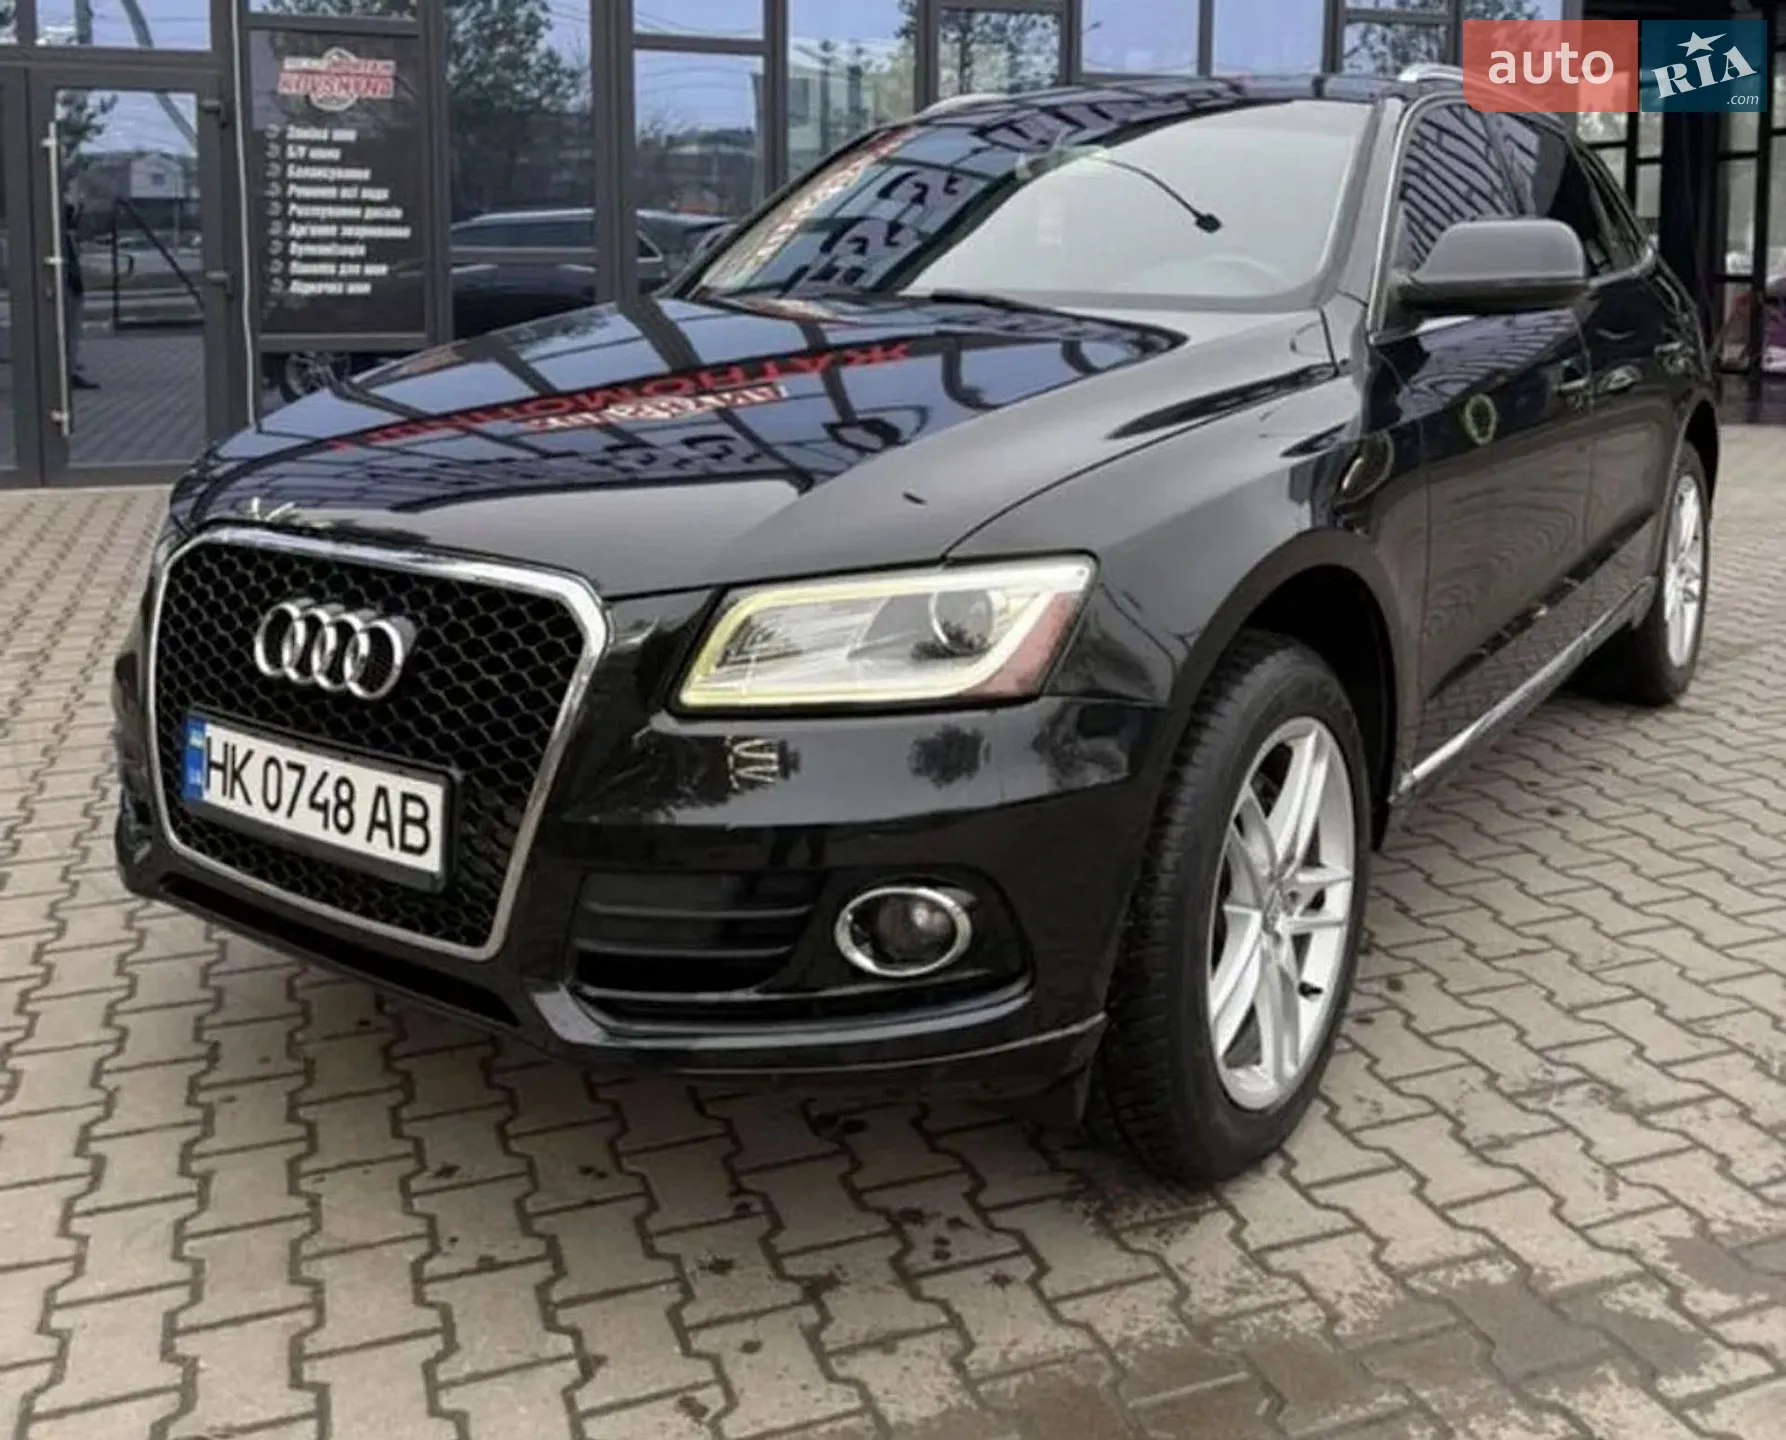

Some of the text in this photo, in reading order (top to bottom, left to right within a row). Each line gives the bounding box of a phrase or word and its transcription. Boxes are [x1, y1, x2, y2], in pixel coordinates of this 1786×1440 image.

[204, 735, 431, 857] HK 0748 AB
